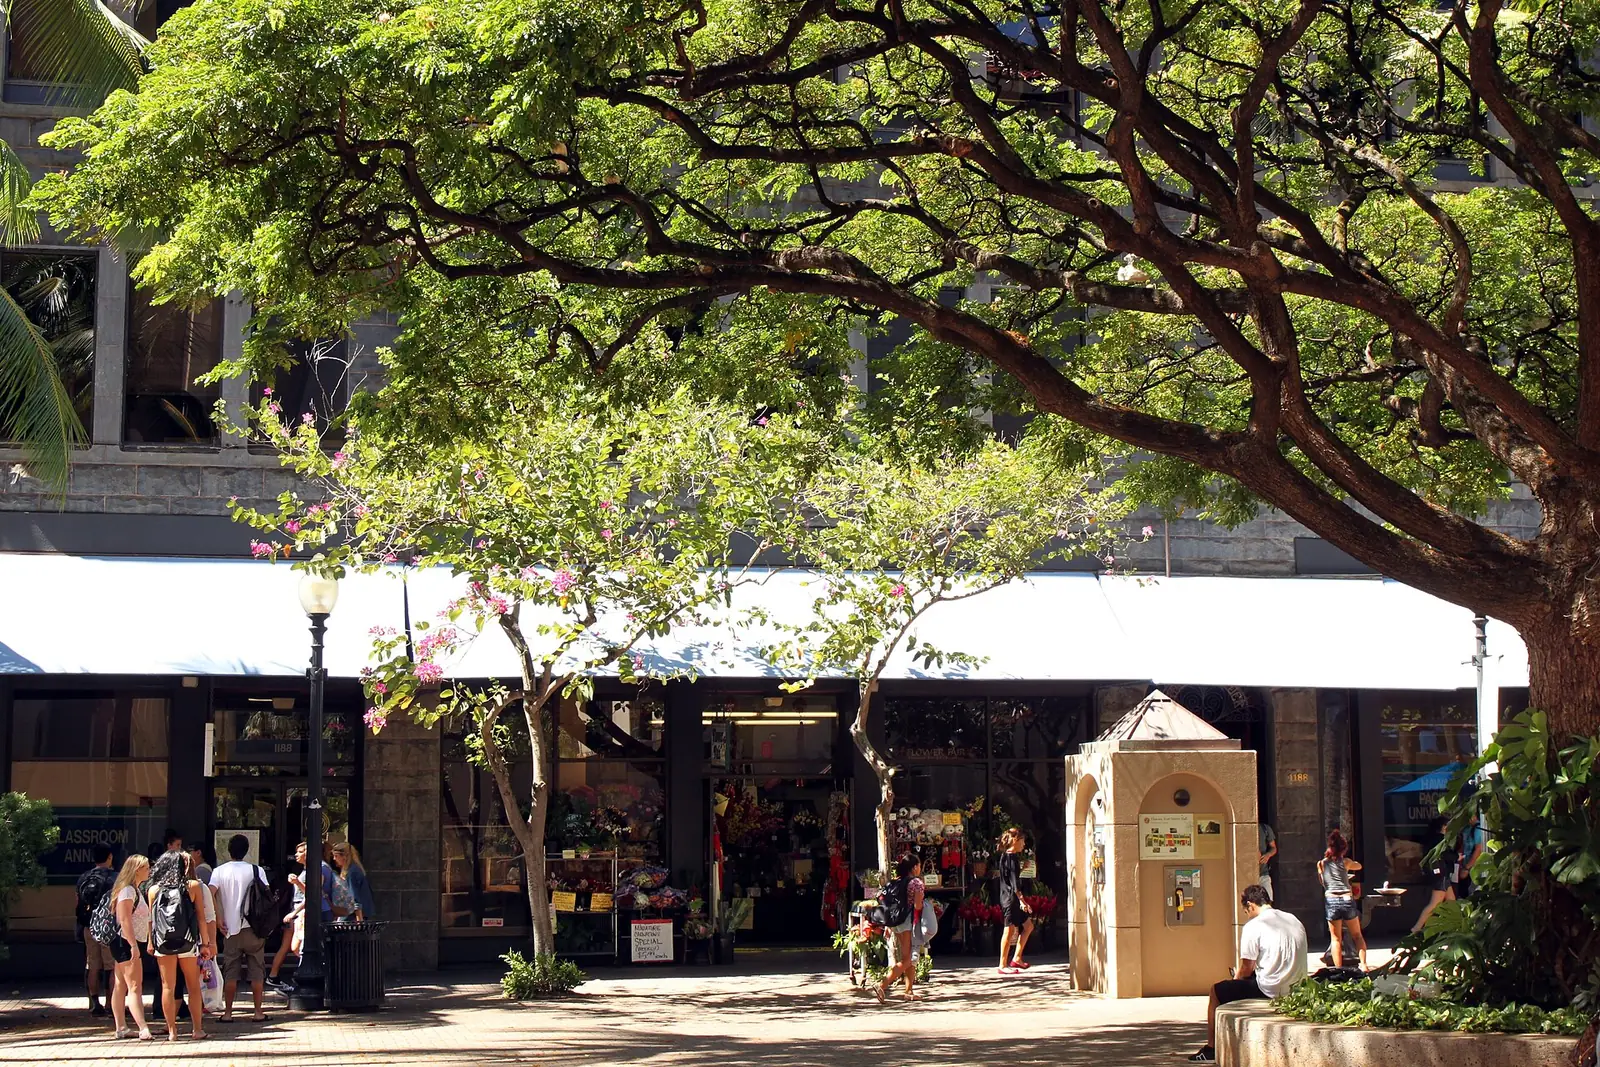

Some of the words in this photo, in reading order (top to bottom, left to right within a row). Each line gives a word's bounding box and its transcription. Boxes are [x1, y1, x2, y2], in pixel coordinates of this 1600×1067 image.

[274, 743, 293, 753] 1188
[907, 747, 944, 757] FLOWER
[57, 829, 129, 844] LASSROOM
[634, 937, 663, 946] SPECIAL
